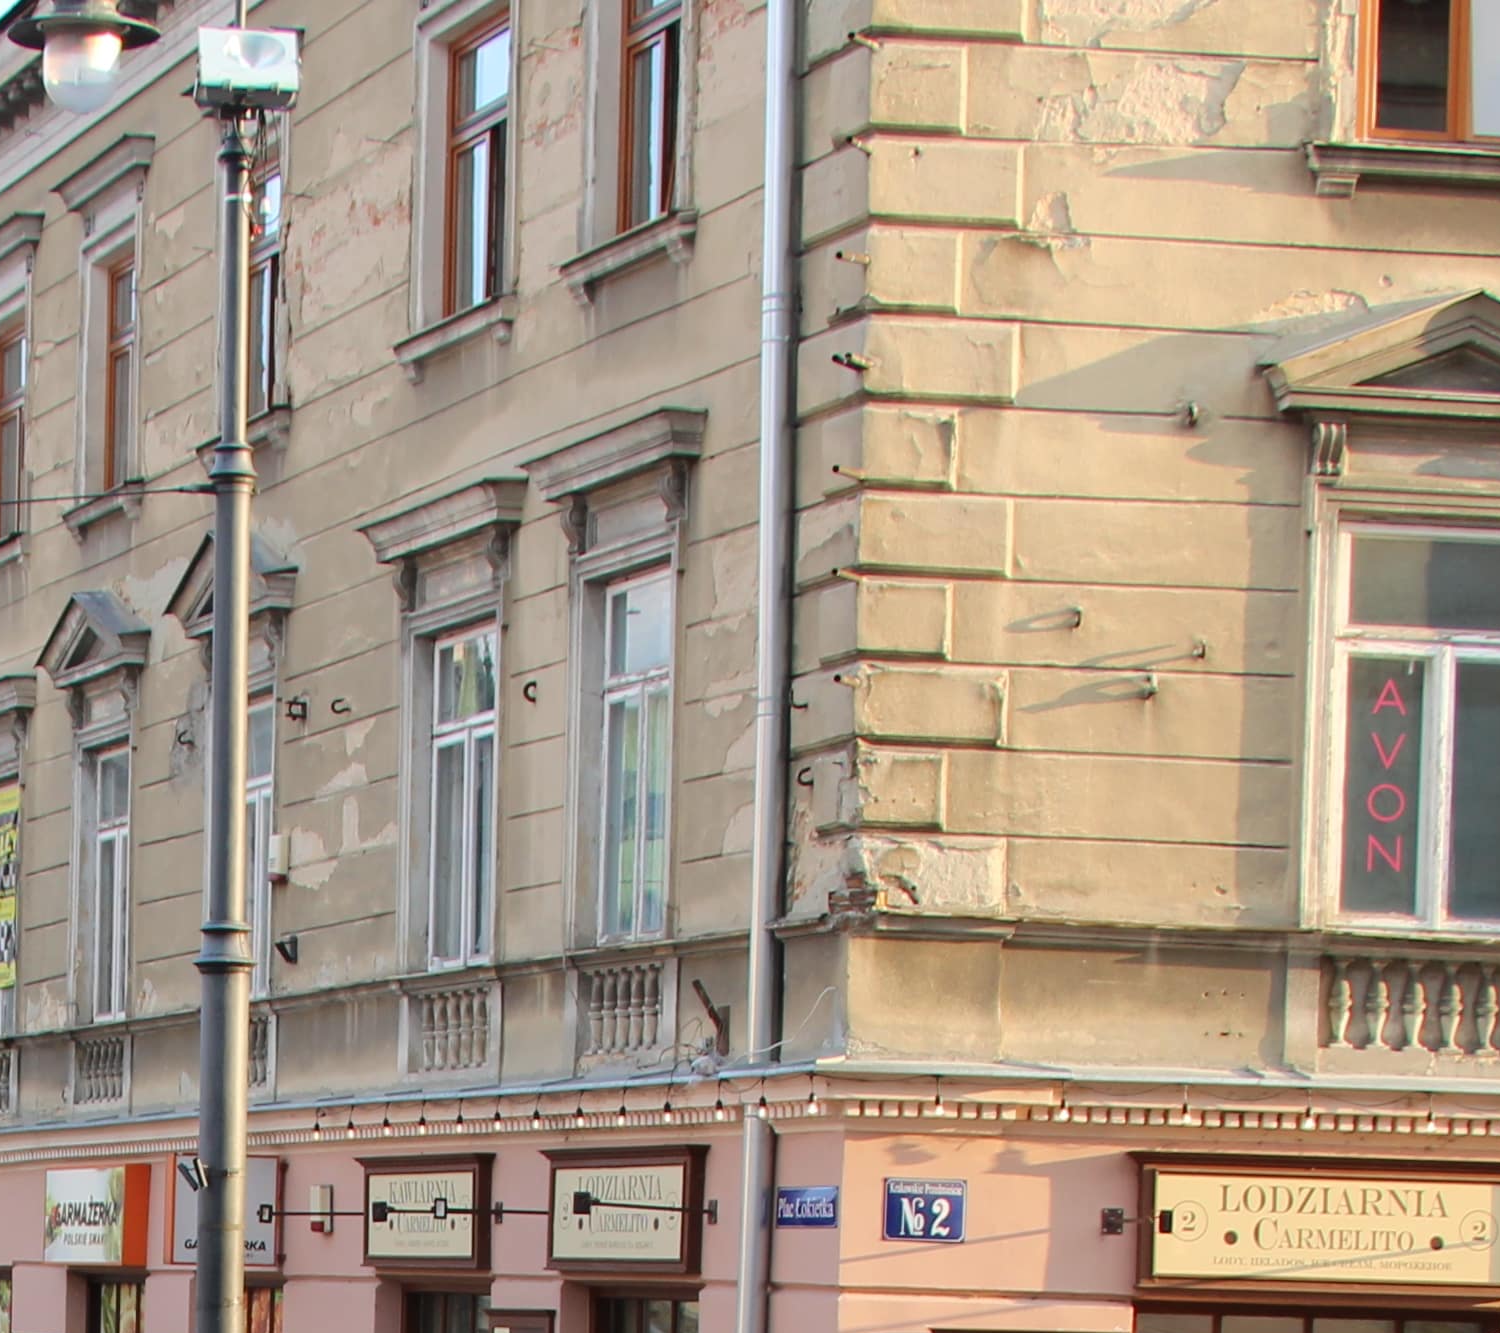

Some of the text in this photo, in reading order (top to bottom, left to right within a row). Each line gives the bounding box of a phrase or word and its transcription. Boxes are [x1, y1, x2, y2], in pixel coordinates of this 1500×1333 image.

[1367, 679, 1407, 873] AVON
[390, 1180, 456, 1204] KAWIARNIA
[1218, 1184, 1450, 1219] LODZIARNIA
[55, 1196, 121, 1228] GARMAŻERKA
[589, 1207, 649, 1234] CARMELITO
[778, 1196, 834, 1219] Plac Łokietka
[931, 1198, 951, 1237] 2
[1181, 1211, 1197, 1232] 2
[1254, 1217, 1416, 1252] CARMELITO
[1471, 1220, 1487, 1241] 2
